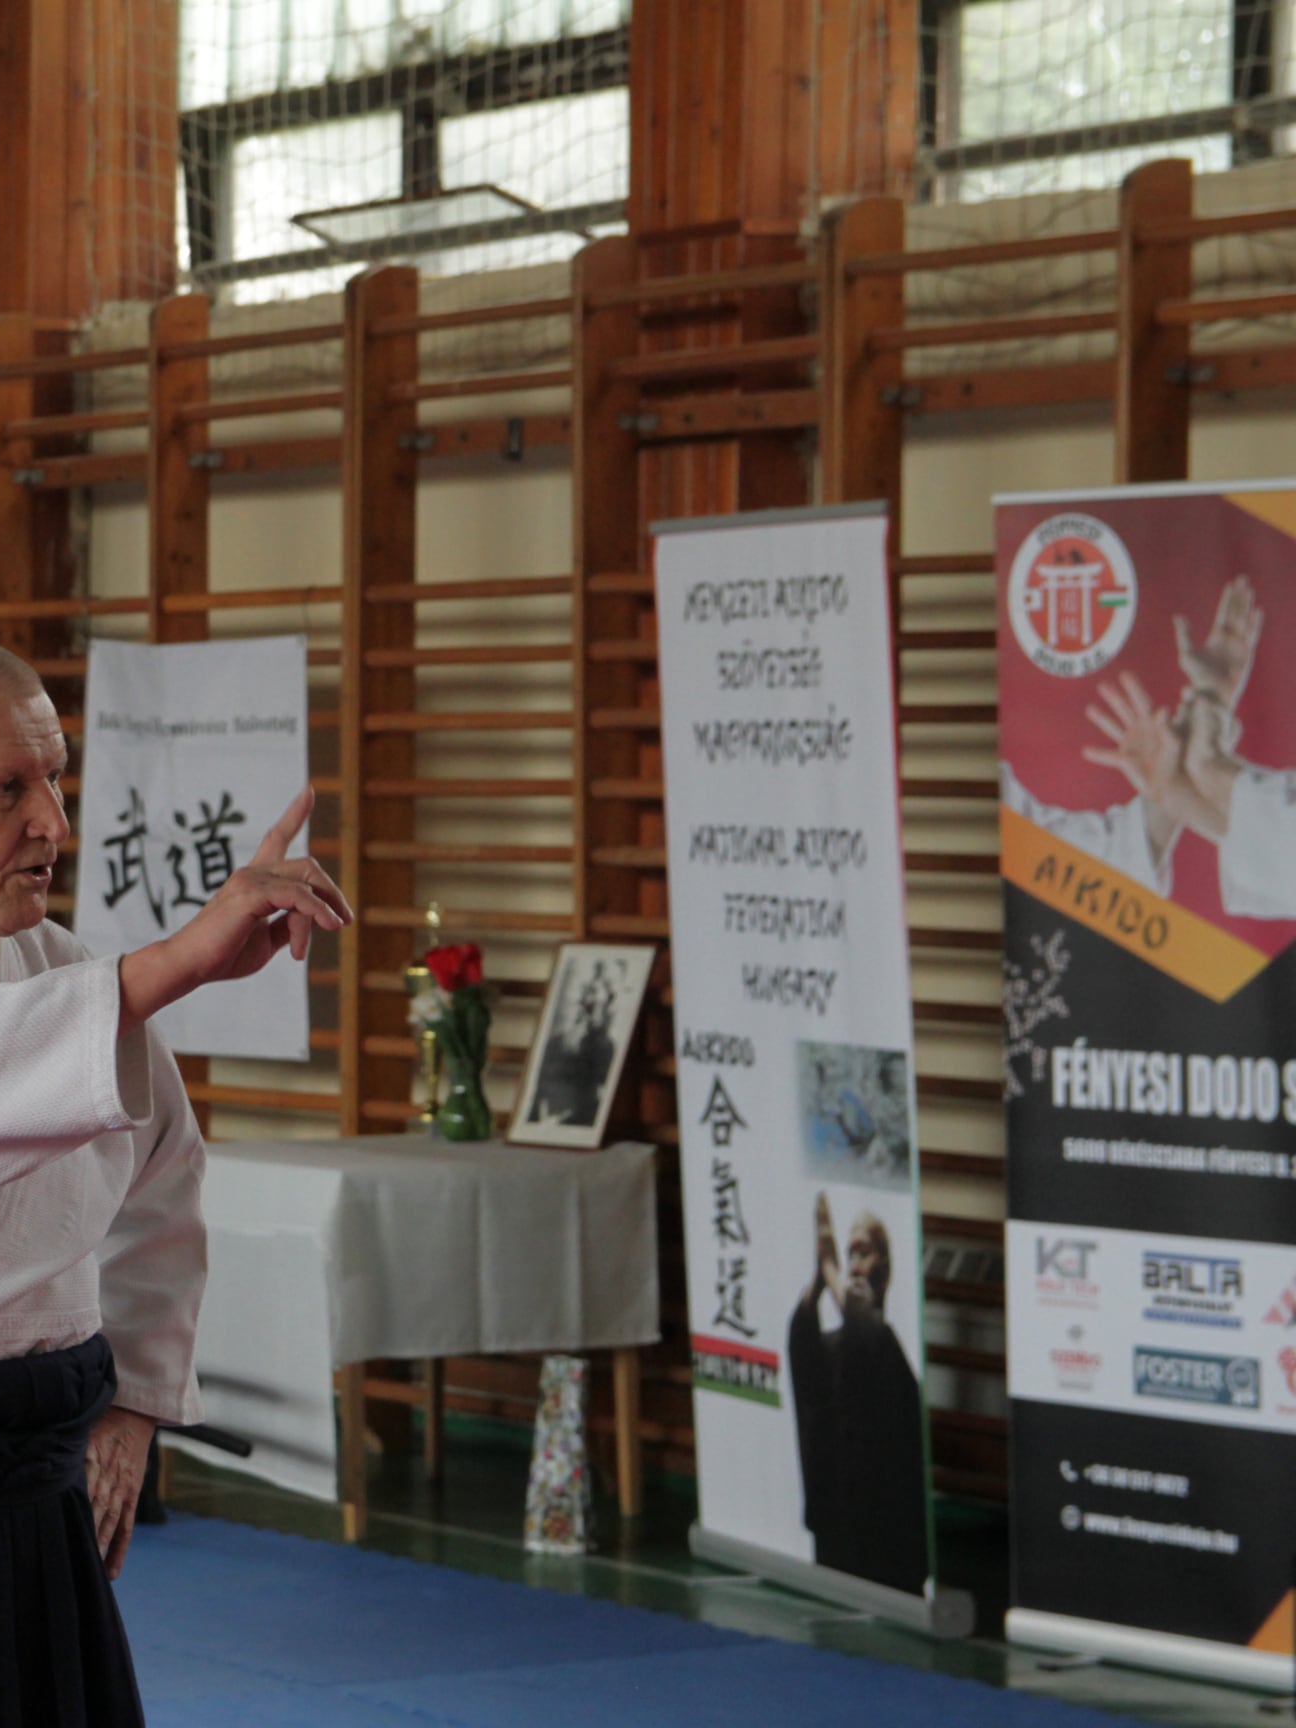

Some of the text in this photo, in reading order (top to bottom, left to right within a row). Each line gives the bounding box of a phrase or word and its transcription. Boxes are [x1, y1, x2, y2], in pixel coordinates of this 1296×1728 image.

[1034, 854, 1171, 951] AIKIDO
[1052, 1036, 1183, 1116] FÉNYESI
[1187, 1054, 1280, 1124] DOJO
